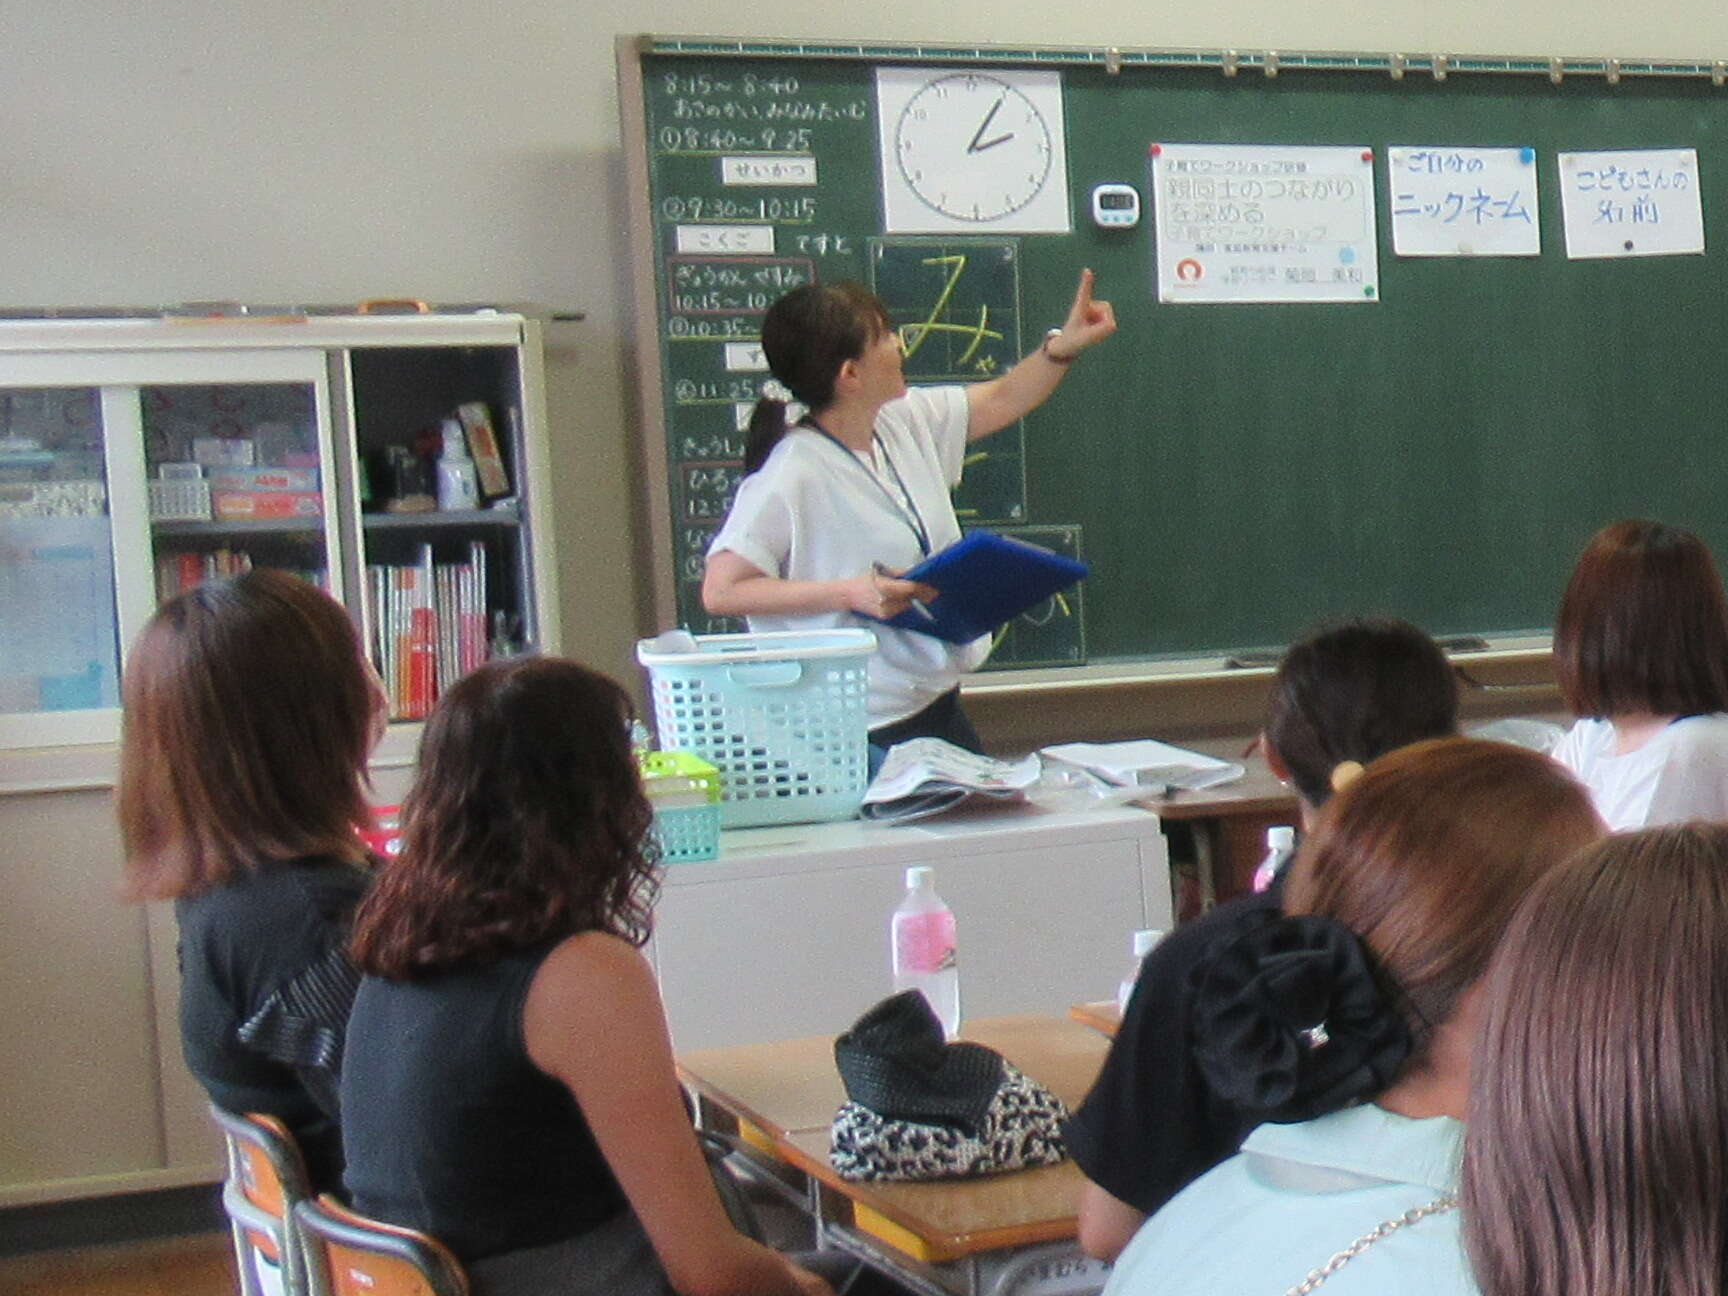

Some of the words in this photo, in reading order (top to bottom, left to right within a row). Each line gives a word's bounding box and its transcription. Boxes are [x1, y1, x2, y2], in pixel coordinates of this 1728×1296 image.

[736, 163, 806, 178] せいかつ
[1408, 152, 1484, 174] ご自分の
[1576, 164, 1690, 191] こどもさんの
[1394, 188, 1533, 225] ニックネーム
[1594, 195, 1660, 225] 名前
[699, 232, 752, 248] こくご
